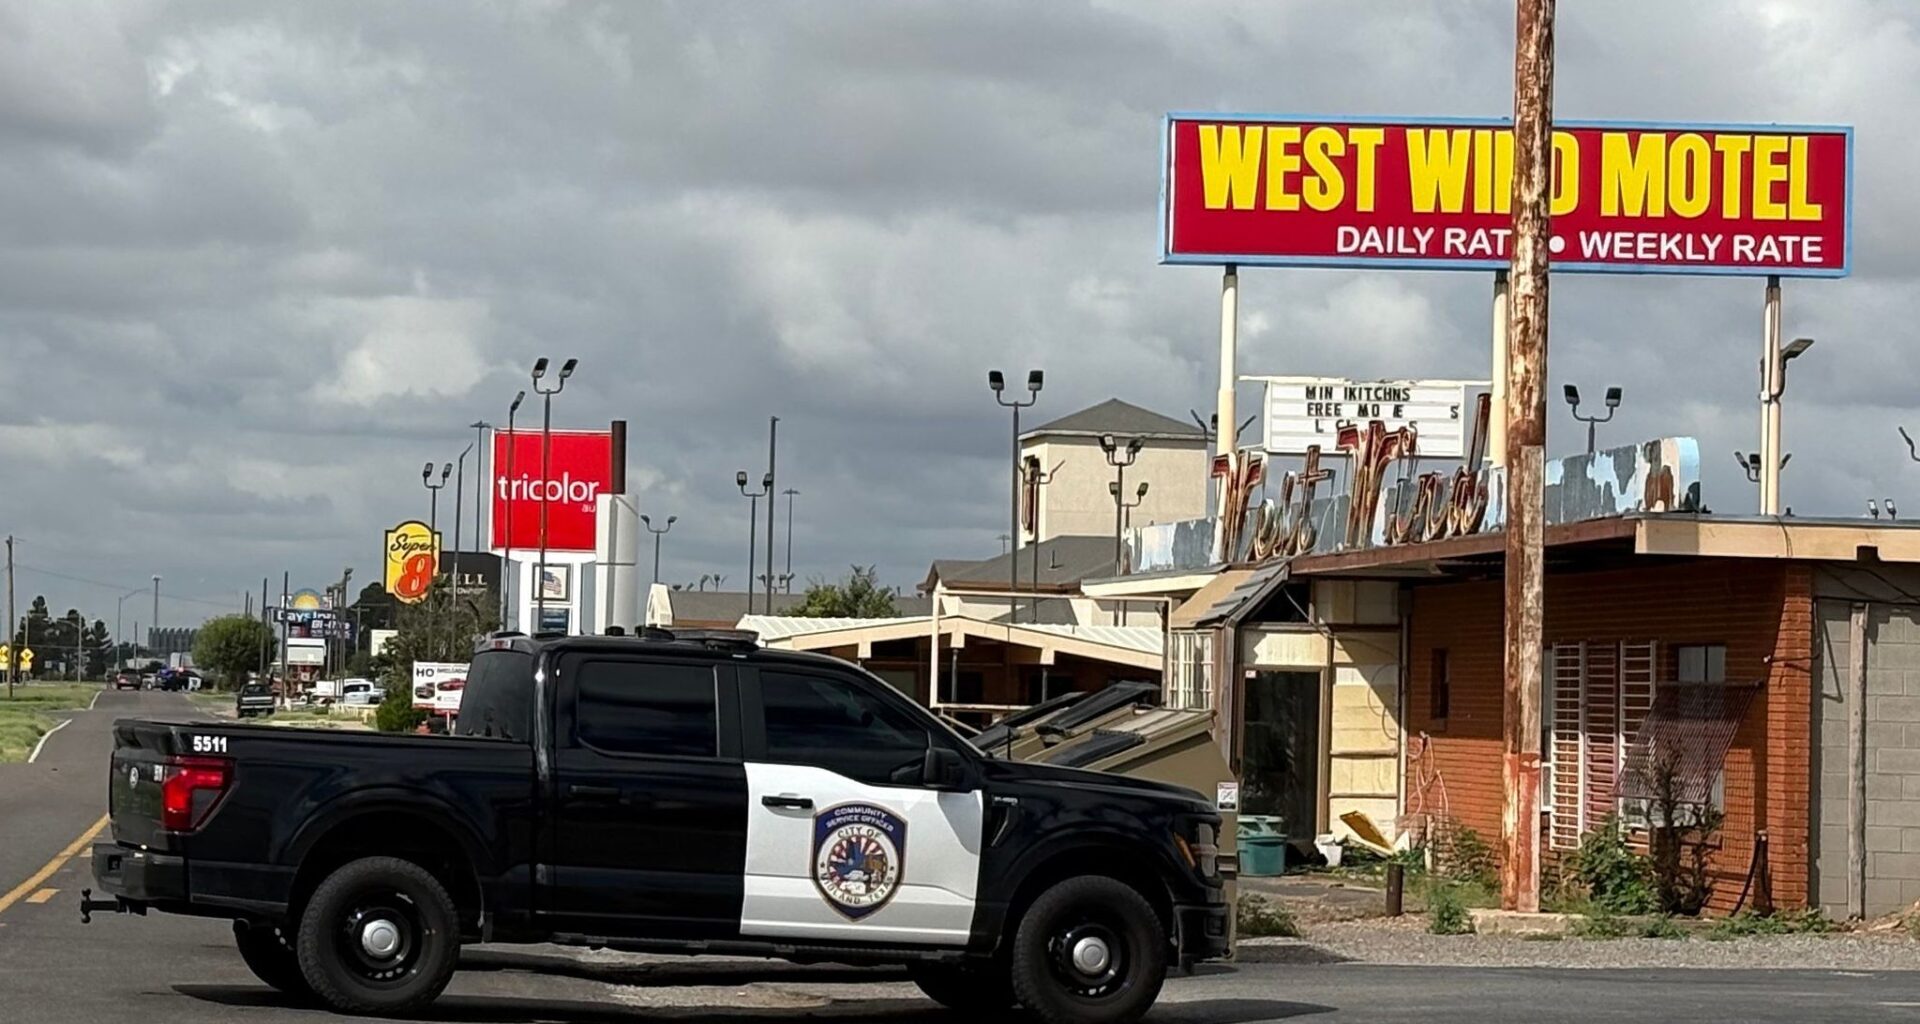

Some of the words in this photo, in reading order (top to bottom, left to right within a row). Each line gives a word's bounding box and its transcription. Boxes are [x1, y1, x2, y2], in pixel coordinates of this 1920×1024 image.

[1199, 124, 1384, 213] WEST
[1600, 132, 1823, 222] MOTEL
[1336, 226, 1437, 255] DAILY
[1443, 227, 1513, 256] RAT
[1578, 230, 1725, 263] WEEKLY
[1732, 234, 1824, 265] RATE
[1305, 386, 1333, 401] MIN
[1307, 402, 1342, 417] FREE
[1449, 404, 1460, 420] S
[497, 471, 600, 504] tricolor
[390, 532, 437, 560] Super
[394, 553, 437, 599] 8
[193, 735, 228, 753] 5511
[825, 814, 860, 829] SERVICE
[861, 815, 894, 832] OFFICER
[834, 807, 887, 819] COMMUNITY
[837, 826, 863, 839] CITY
[866, 828, 883, 839] OF
[868, 875, 895, 902] TEXAS
